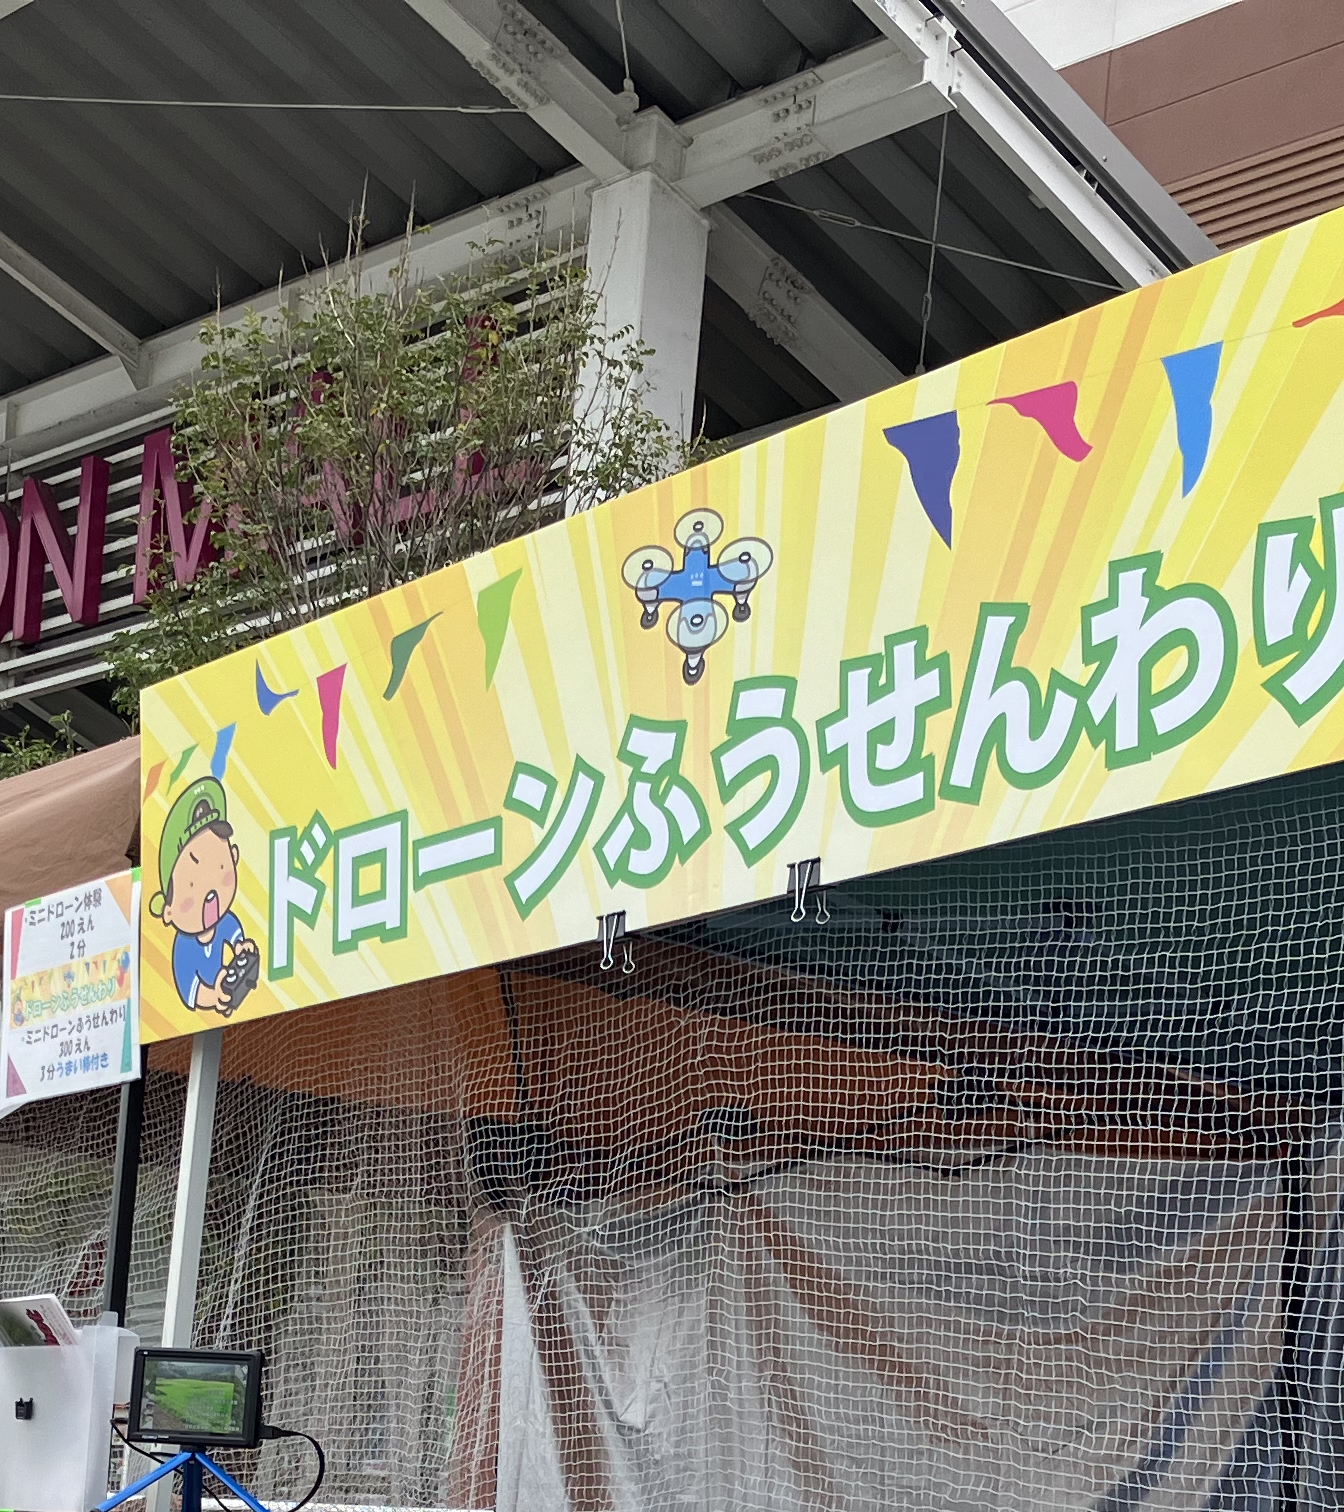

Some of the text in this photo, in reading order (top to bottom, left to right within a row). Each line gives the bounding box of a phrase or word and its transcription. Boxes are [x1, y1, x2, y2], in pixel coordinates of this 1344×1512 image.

[24, 976, 117, 1022] ドローンふうせんわり
